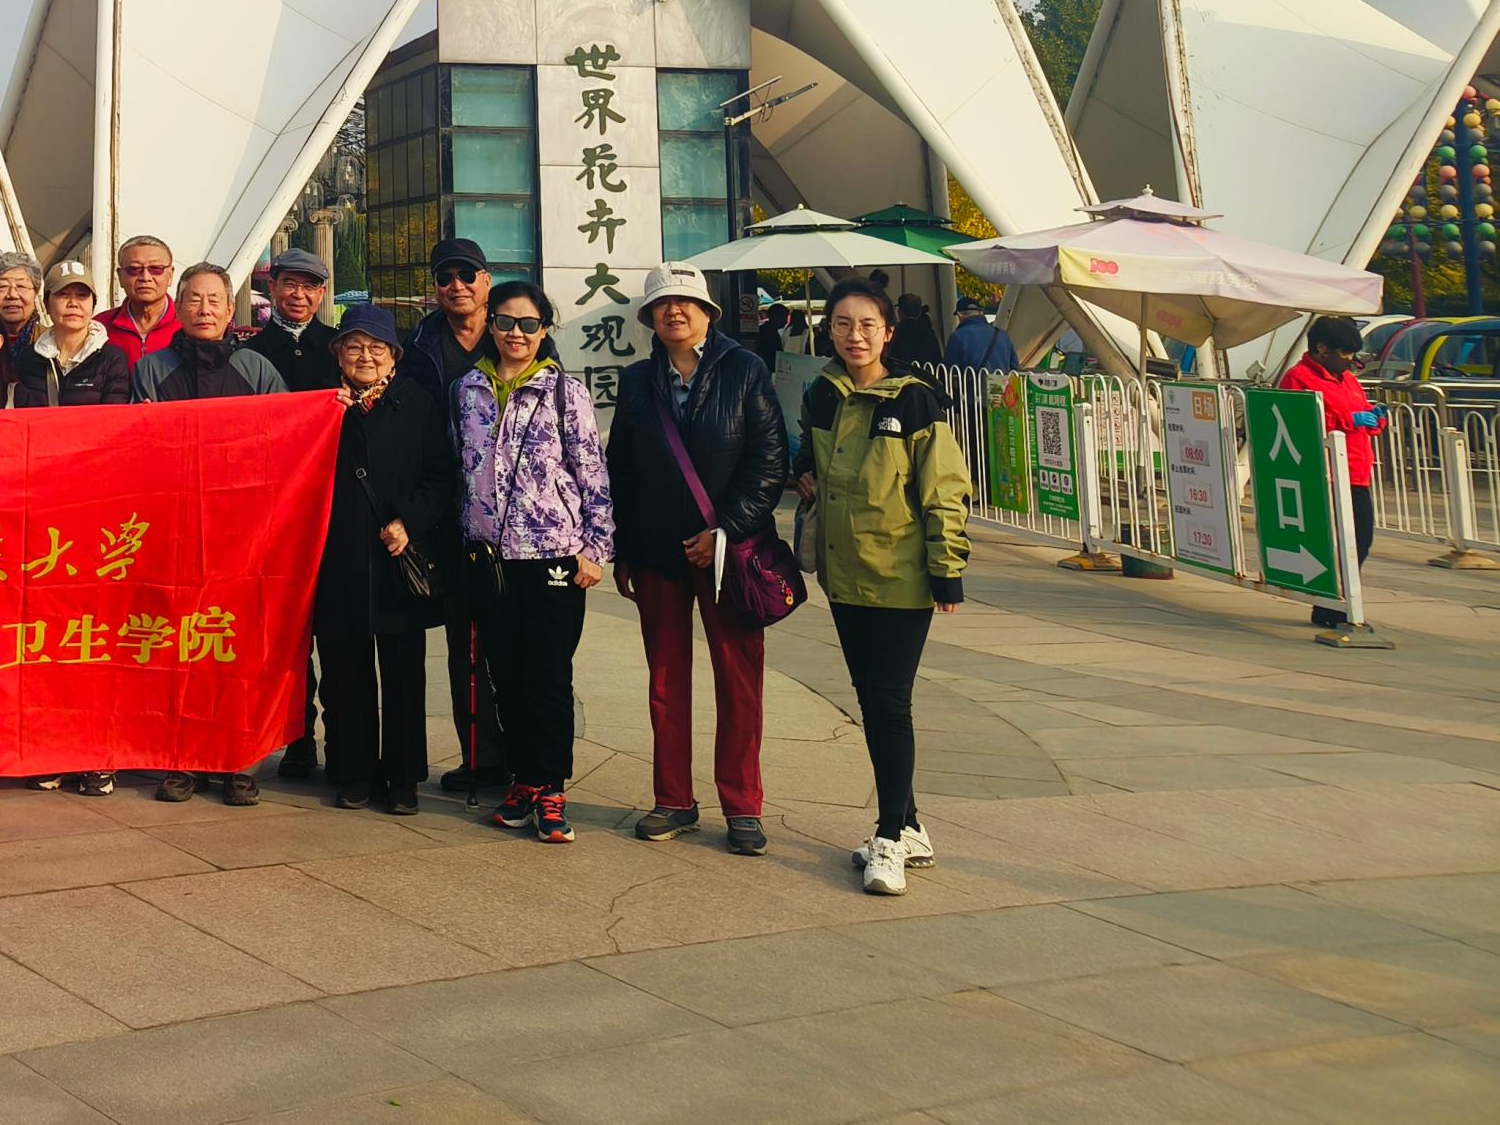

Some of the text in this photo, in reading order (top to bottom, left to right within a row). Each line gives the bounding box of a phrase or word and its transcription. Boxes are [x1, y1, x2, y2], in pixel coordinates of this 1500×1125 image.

[564, 43, 636, 409] 世界花卉大观园
[1193, 395, 1215, 418] 日场
[1185, 447, 1204, 461] 08:00
[1268, 403, 1306, 534] 入口
[1189, 487, 1208, 502] 16:30
[1193, 531, 1212, 546] 17:30
